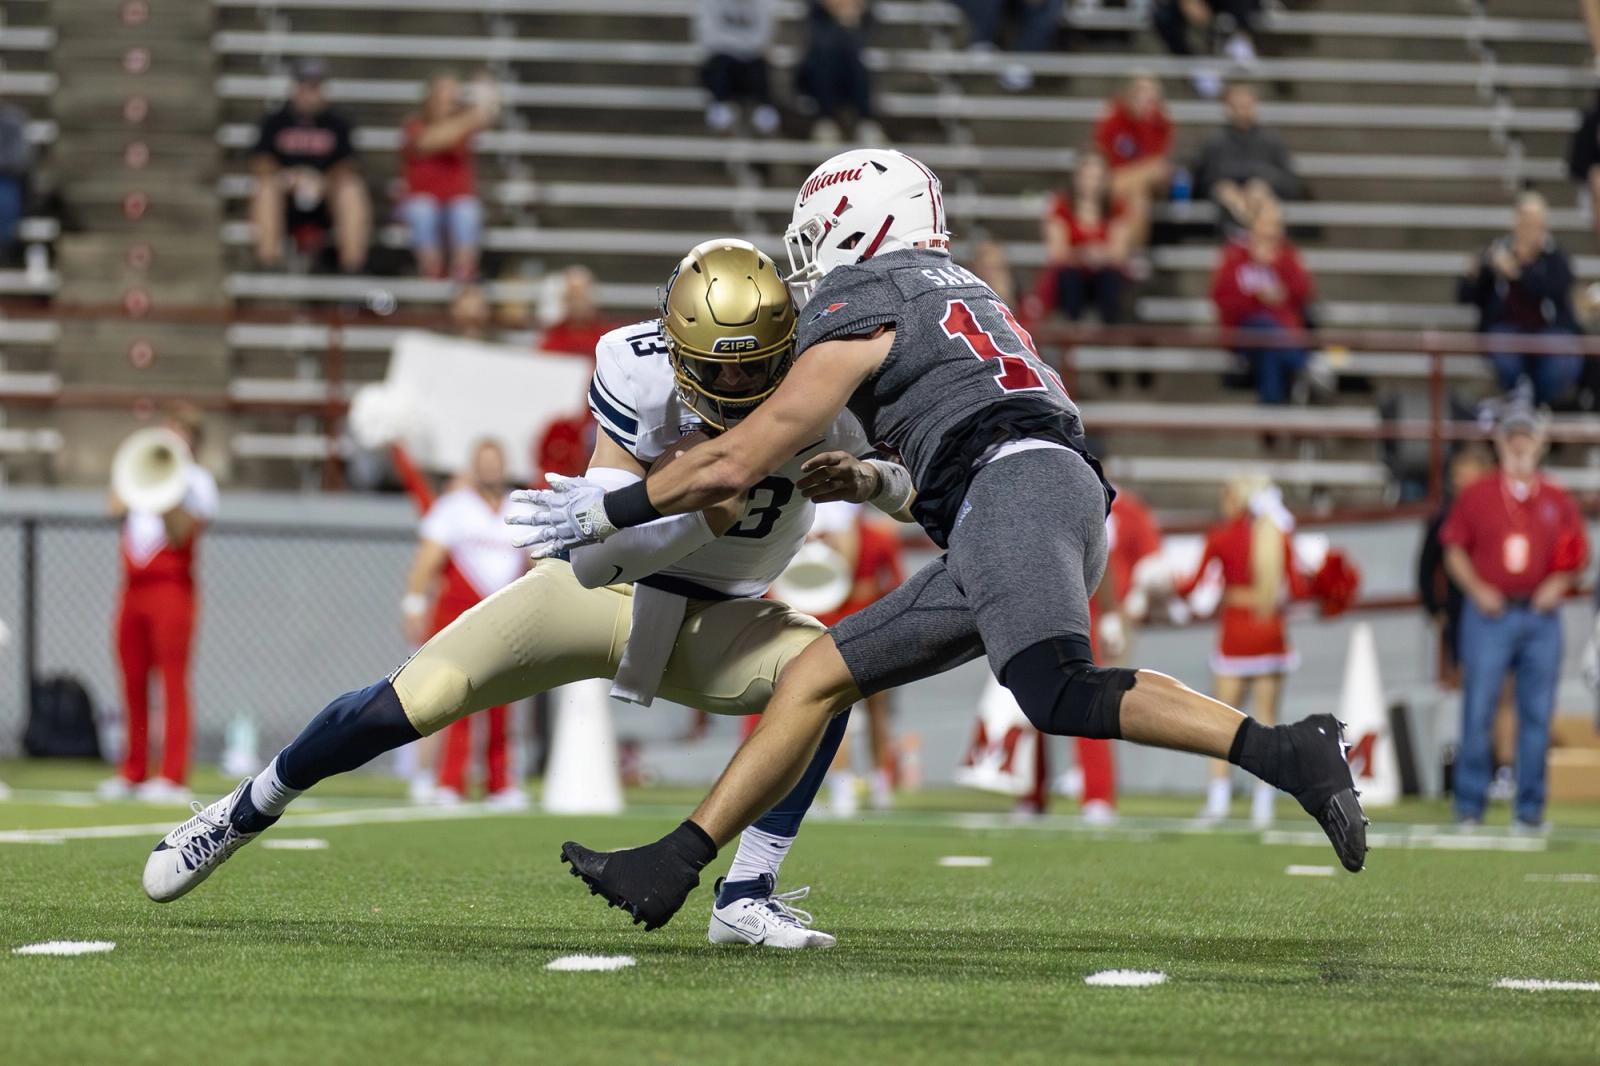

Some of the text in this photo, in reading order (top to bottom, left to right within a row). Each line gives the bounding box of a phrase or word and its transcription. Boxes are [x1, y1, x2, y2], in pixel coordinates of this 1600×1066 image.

[801, 162, 868, 202] Miami
[625, 331, 670, 357] 13
[720, 340, 756, 351] ZIPS
